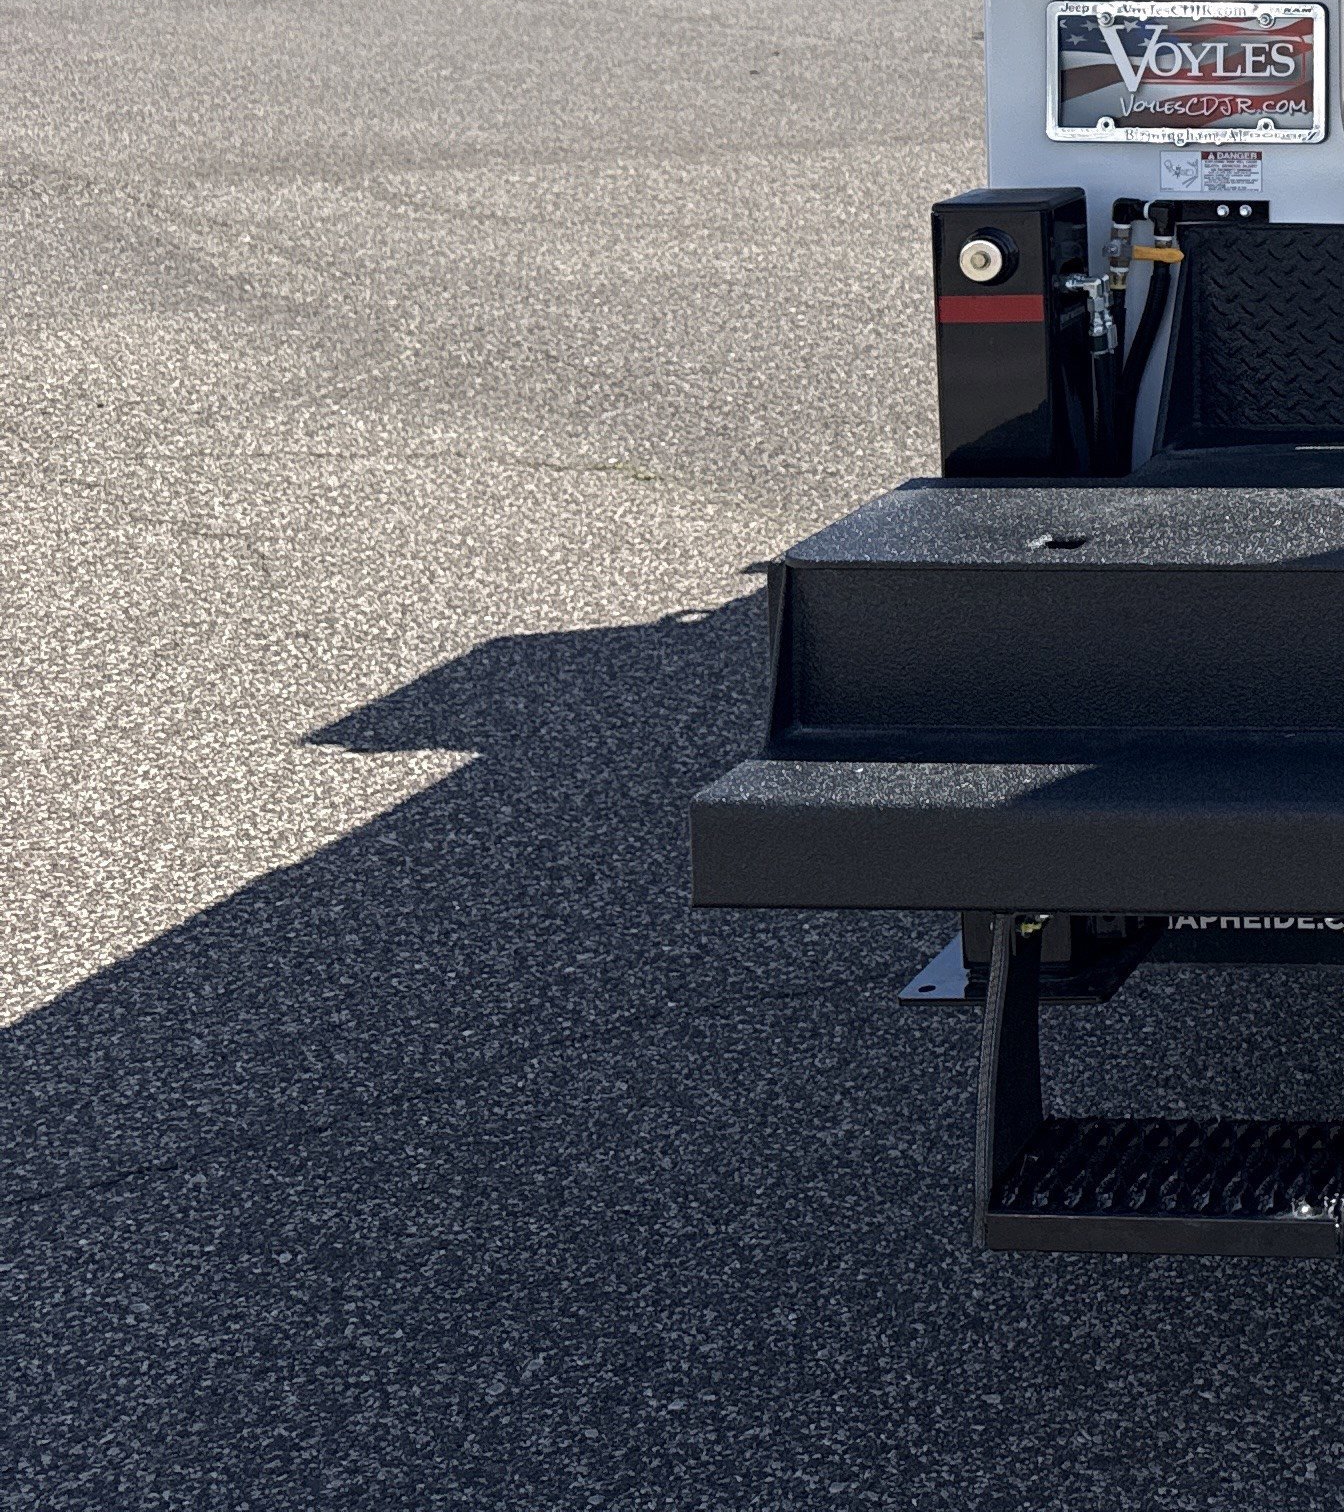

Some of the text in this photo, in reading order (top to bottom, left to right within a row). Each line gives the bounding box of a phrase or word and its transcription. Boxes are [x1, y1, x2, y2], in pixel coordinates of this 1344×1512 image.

[1060, 2, 1090, 15] Jeep
[1100, 24, 1295, 92] VOYLES
[1216, 151, 1258, 160] DANGER
